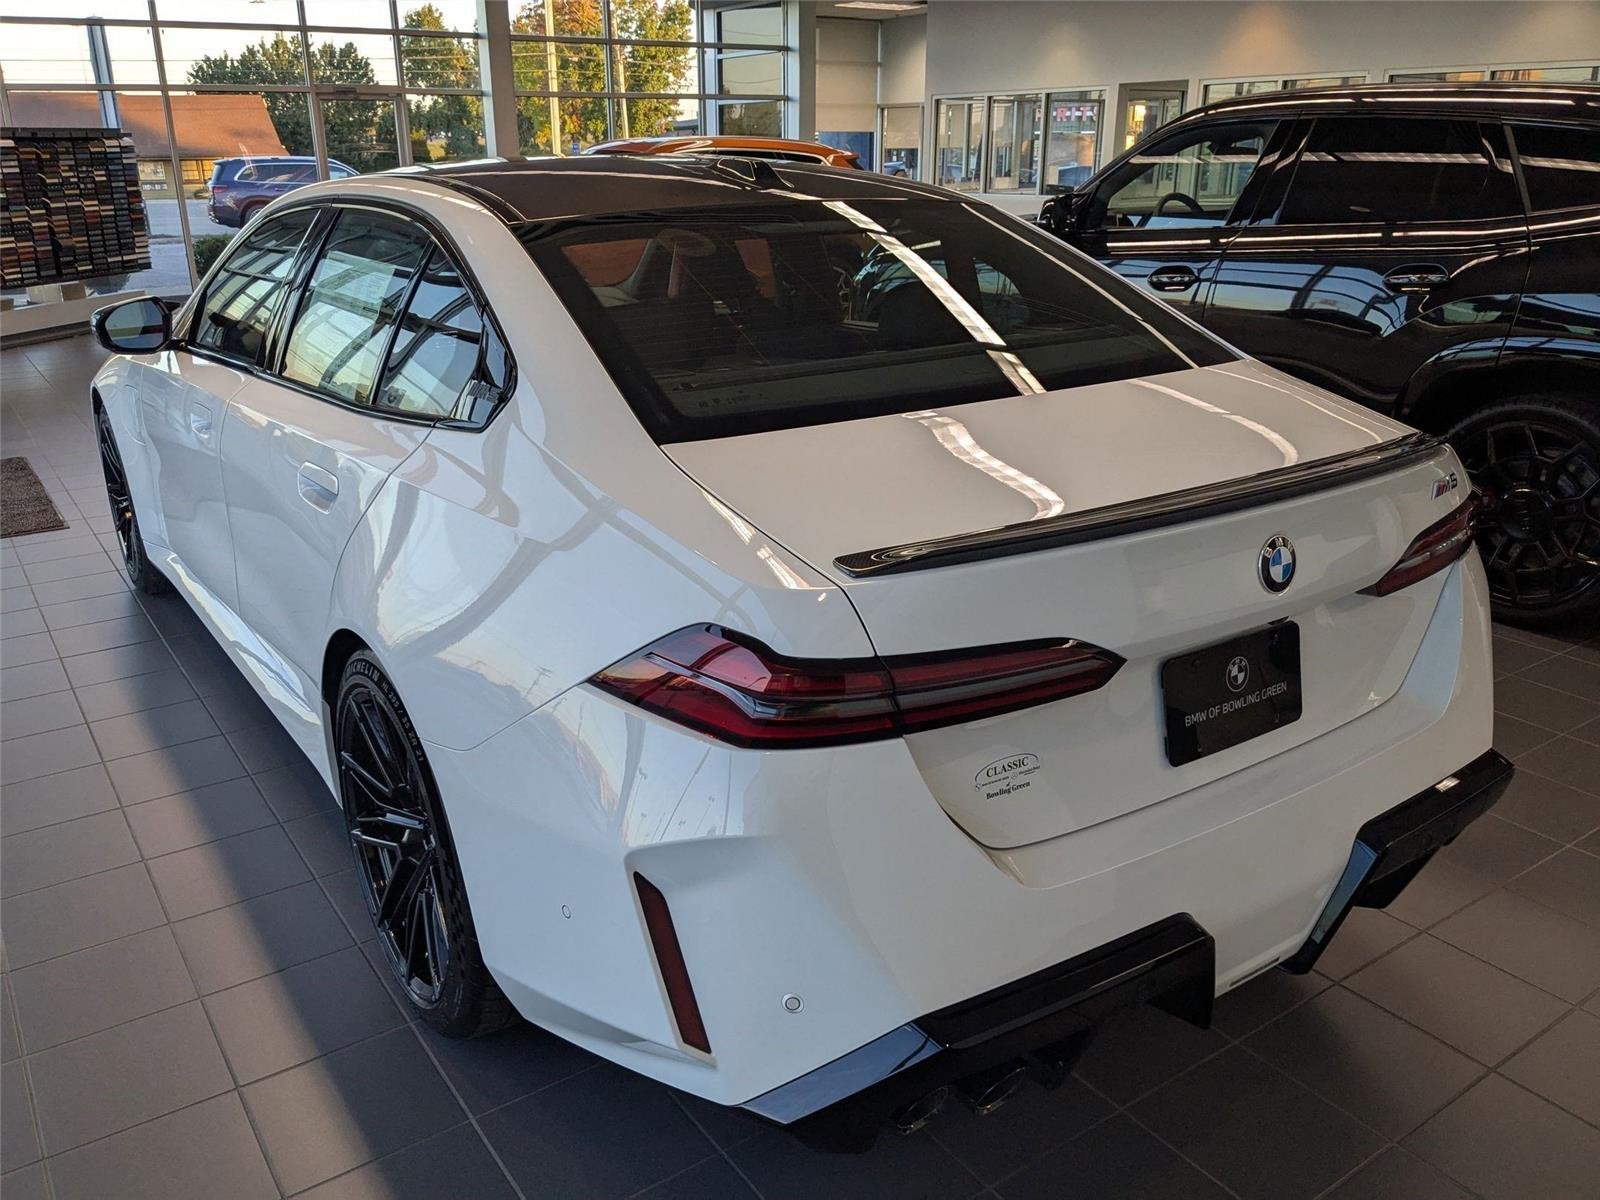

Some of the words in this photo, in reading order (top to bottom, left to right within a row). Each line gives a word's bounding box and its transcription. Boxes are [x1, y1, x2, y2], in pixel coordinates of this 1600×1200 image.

[1431, 472, 1458, 500] M5
[346, 661, 380, 682] MICHELIN
[1184, 710, 1208, 727] BMW
[1208, 704, 1222, 719] OF
[1222, 691, 1260, 713] BOWLING
[1262, 681, 1287, 699] GREEN
[986, 757, 1029, 777] CLASSIC
[986, 786, 1012, 800] Bowling
[1012, 781, 1030, 792] Green
